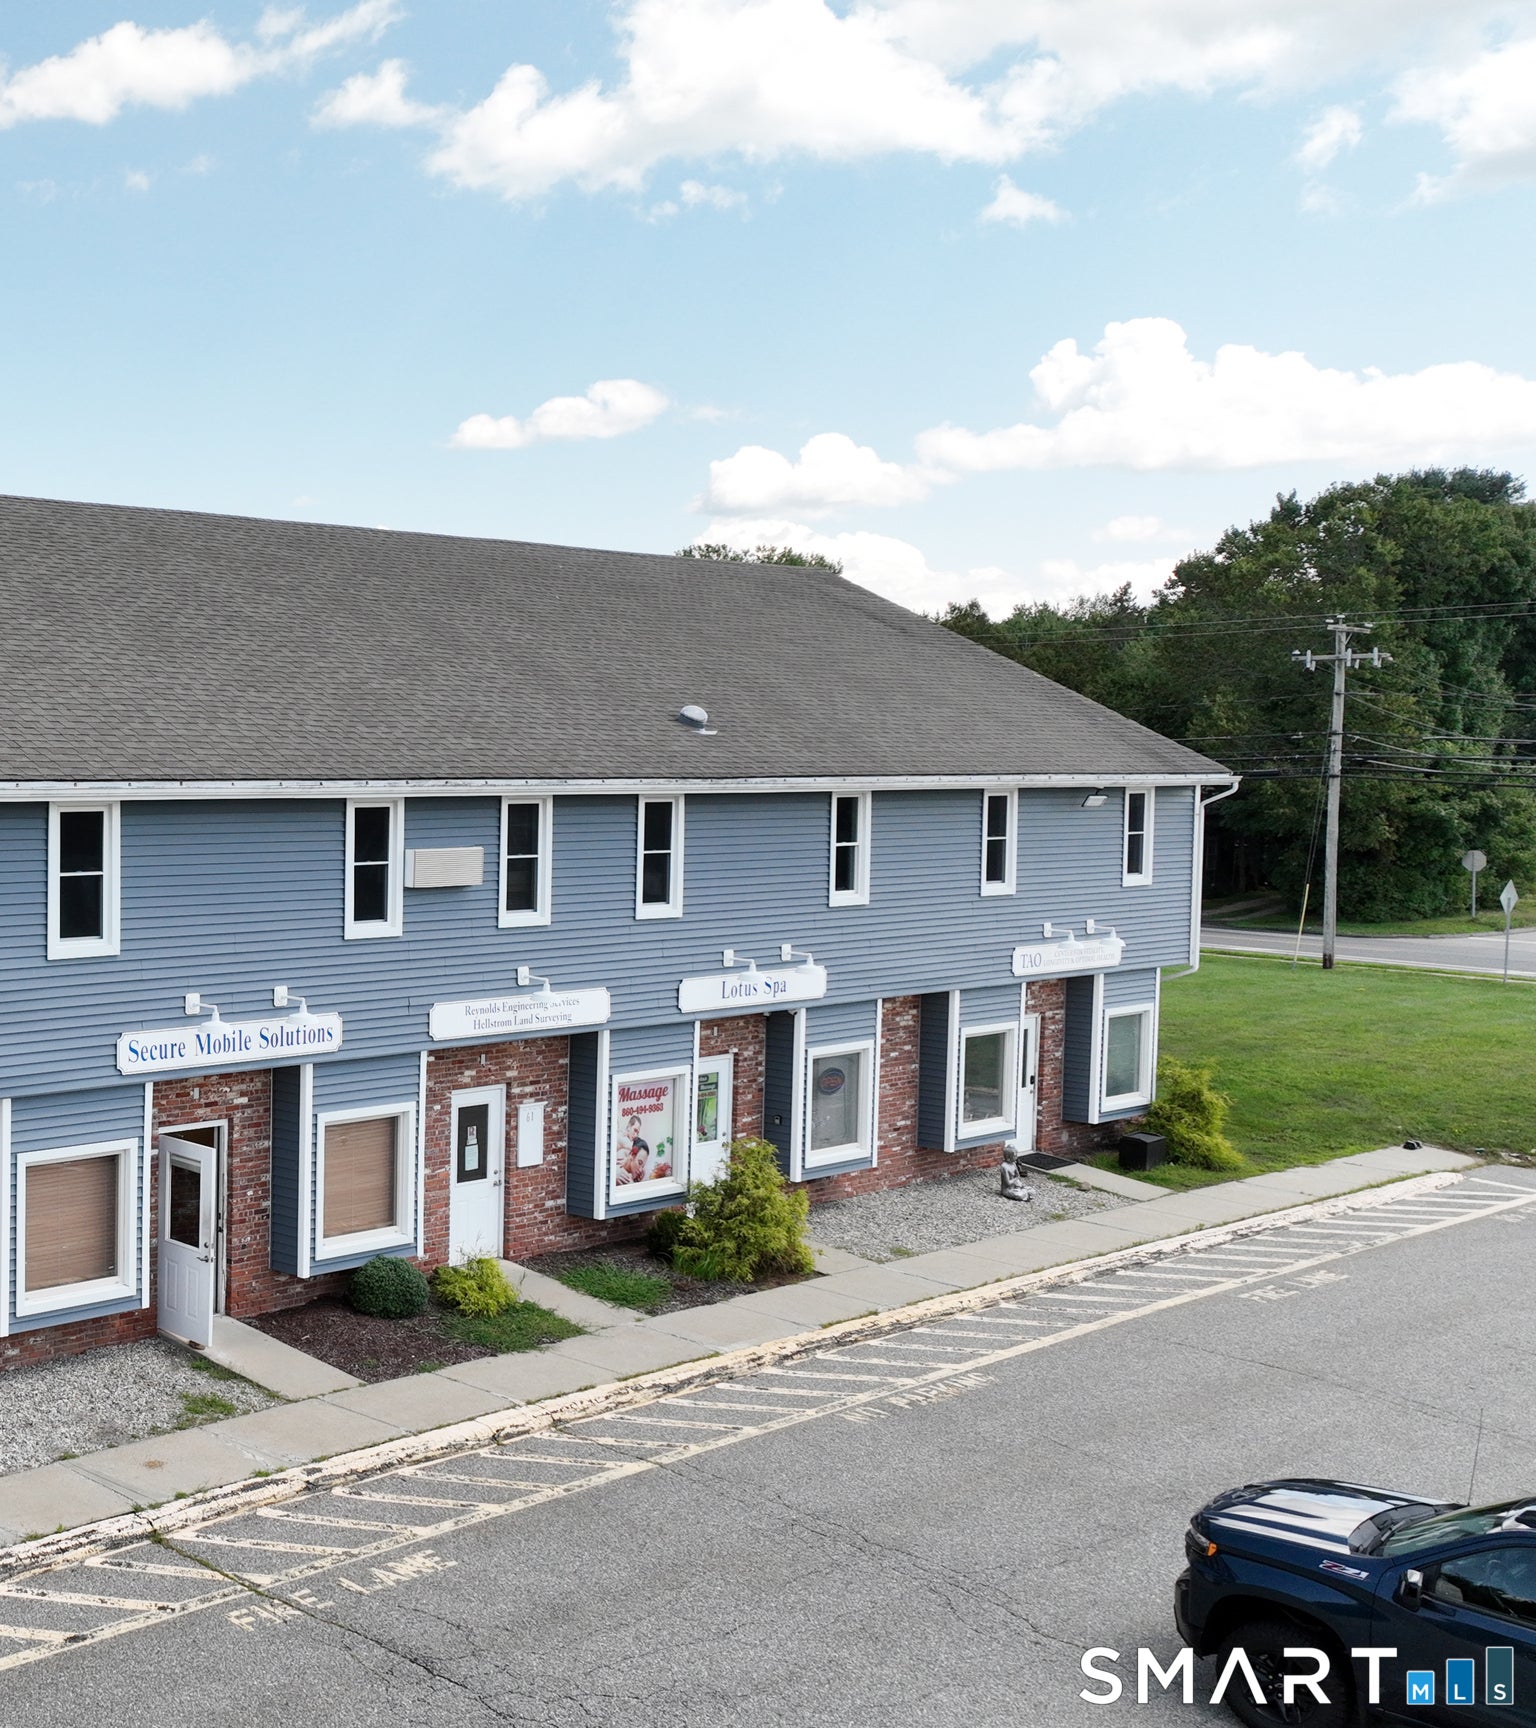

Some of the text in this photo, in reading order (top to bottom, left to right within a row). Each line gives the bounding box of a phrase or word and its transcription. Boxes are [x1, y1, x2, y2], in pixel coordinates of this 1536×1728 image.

[1020, 952, 1042, 969] TAO
[722, 976, 787, 999] Lotus Spa
[465, 1003, 501, 1018] Reynolds
[502, 1000, 549, 1014] Engineering
[473, 1012, 573, 1031] Hellstrom Land Surveying
[128, 1024, 333, 1064] Secure Mobile Solutions
[618, 1085, 669, 1104] Massage
[337, 1549, 459, 1596] LANE
